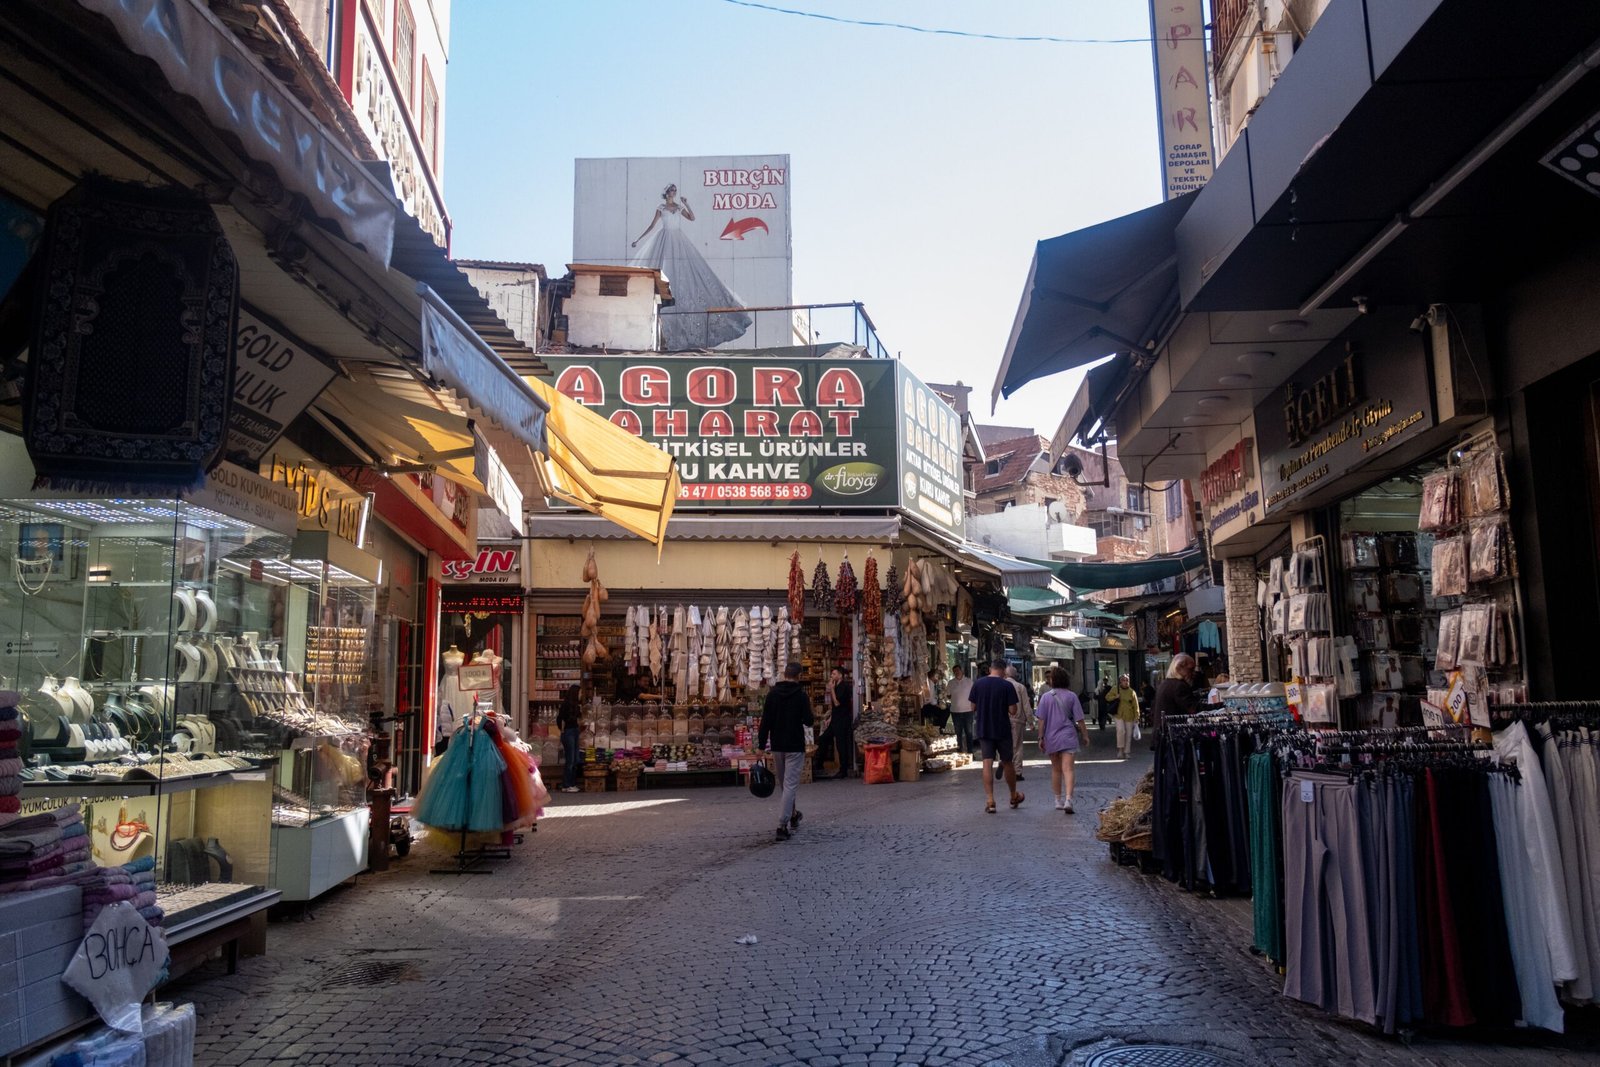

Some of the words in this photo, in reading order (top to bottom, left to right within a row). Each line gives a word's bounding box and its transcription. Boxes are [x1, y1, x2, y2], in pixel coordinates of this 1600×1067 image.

[1169, 151, 1207, 160] ÇAMAŞIR
[1173, 144, 1202, 152] ÇORAP
[1168, 159, 1210, 167] DEPOLARI
[704, 165, 785, 190] BURÇİN
[1169, 183, 1207, 191] ÜRÜNLE
[1173, 174, 1208, 183] TEKSTİL
[713, 193, 777, 210] MODA
[237, 325, 294, 373] GOLD
[554, 365, 865, 407] AGORA
[608, 409, 859, 437] AHARAT
[904, 376, 959, 454] AGORA
[759, 439, 867, 458] ÜRÜNLER
[906, 417, 958, 478] BAHARAT
[210, 468, 238, 489] GOLD
[708, 463, 800, 480] KAHVE
[824, 473, 835, 481] dr.
[833, 466, 875, 490] floya
[692, 485, 707, 498] 47
[717, 485, 747, 498] 0538
[750, 485, 772, 498] 568
[775, 485, 790, 498] 56
[792, 485, 808, 498] 93
[919, 476, 934, 499] KURU
[1450, 694, 1462, 715] 200
[84, 925, 155, 980] BOHÇA
